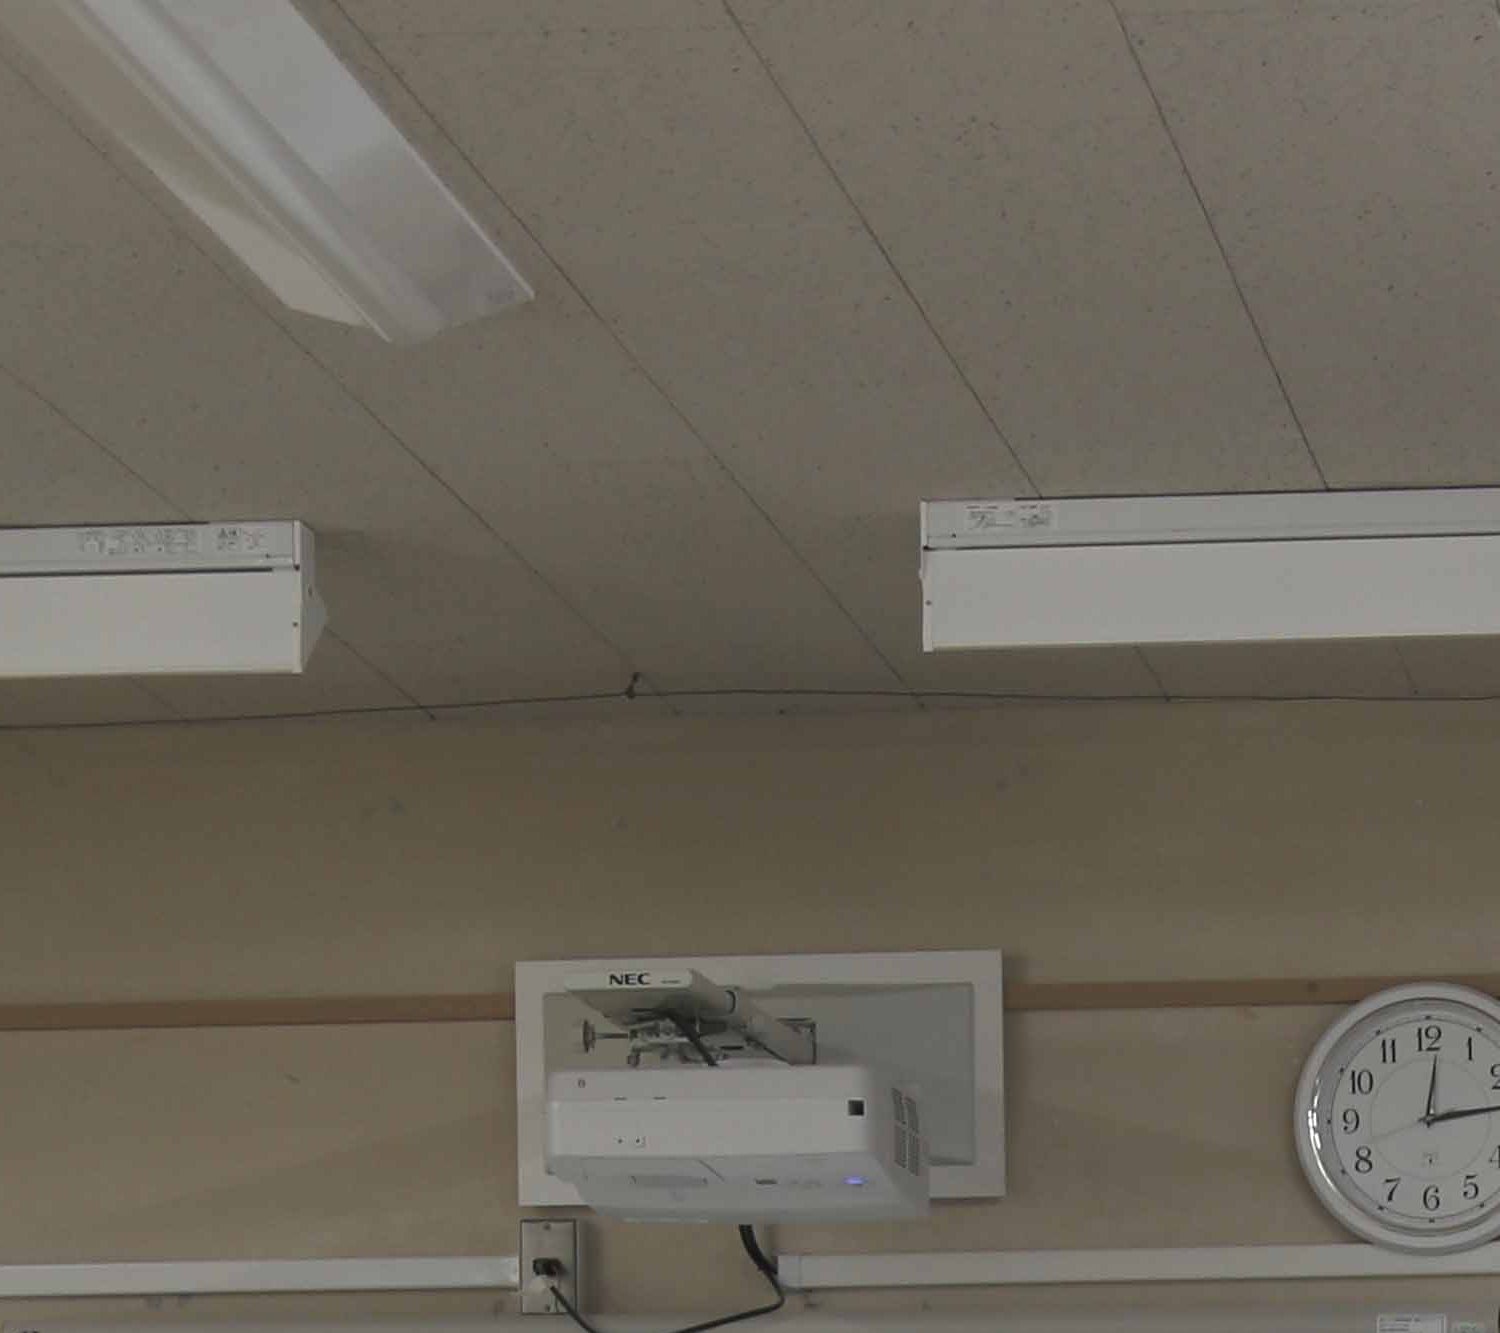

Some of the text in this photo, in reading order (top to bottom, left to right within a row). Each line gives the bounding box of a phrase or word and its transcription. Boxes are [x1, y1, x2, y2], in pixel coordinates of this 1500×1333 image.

[608, 972, 651, 986] NEC
[1381, 1038, 1397, 1063] 11
[1416, 1025, 1442, 1052] 12
[1467, 1036, 1473, 1061] 1
[1350, 1069, 1374, 1095] 10
[1342, 1108, 1360, 1134] 9
[1354, 1146, 1373, 1174] 8
[1384, 1177, 1401, 1202] 7
[1422, 1185, 1441, 1211] 6
[1462, 1174, 1479, 1200] 5
